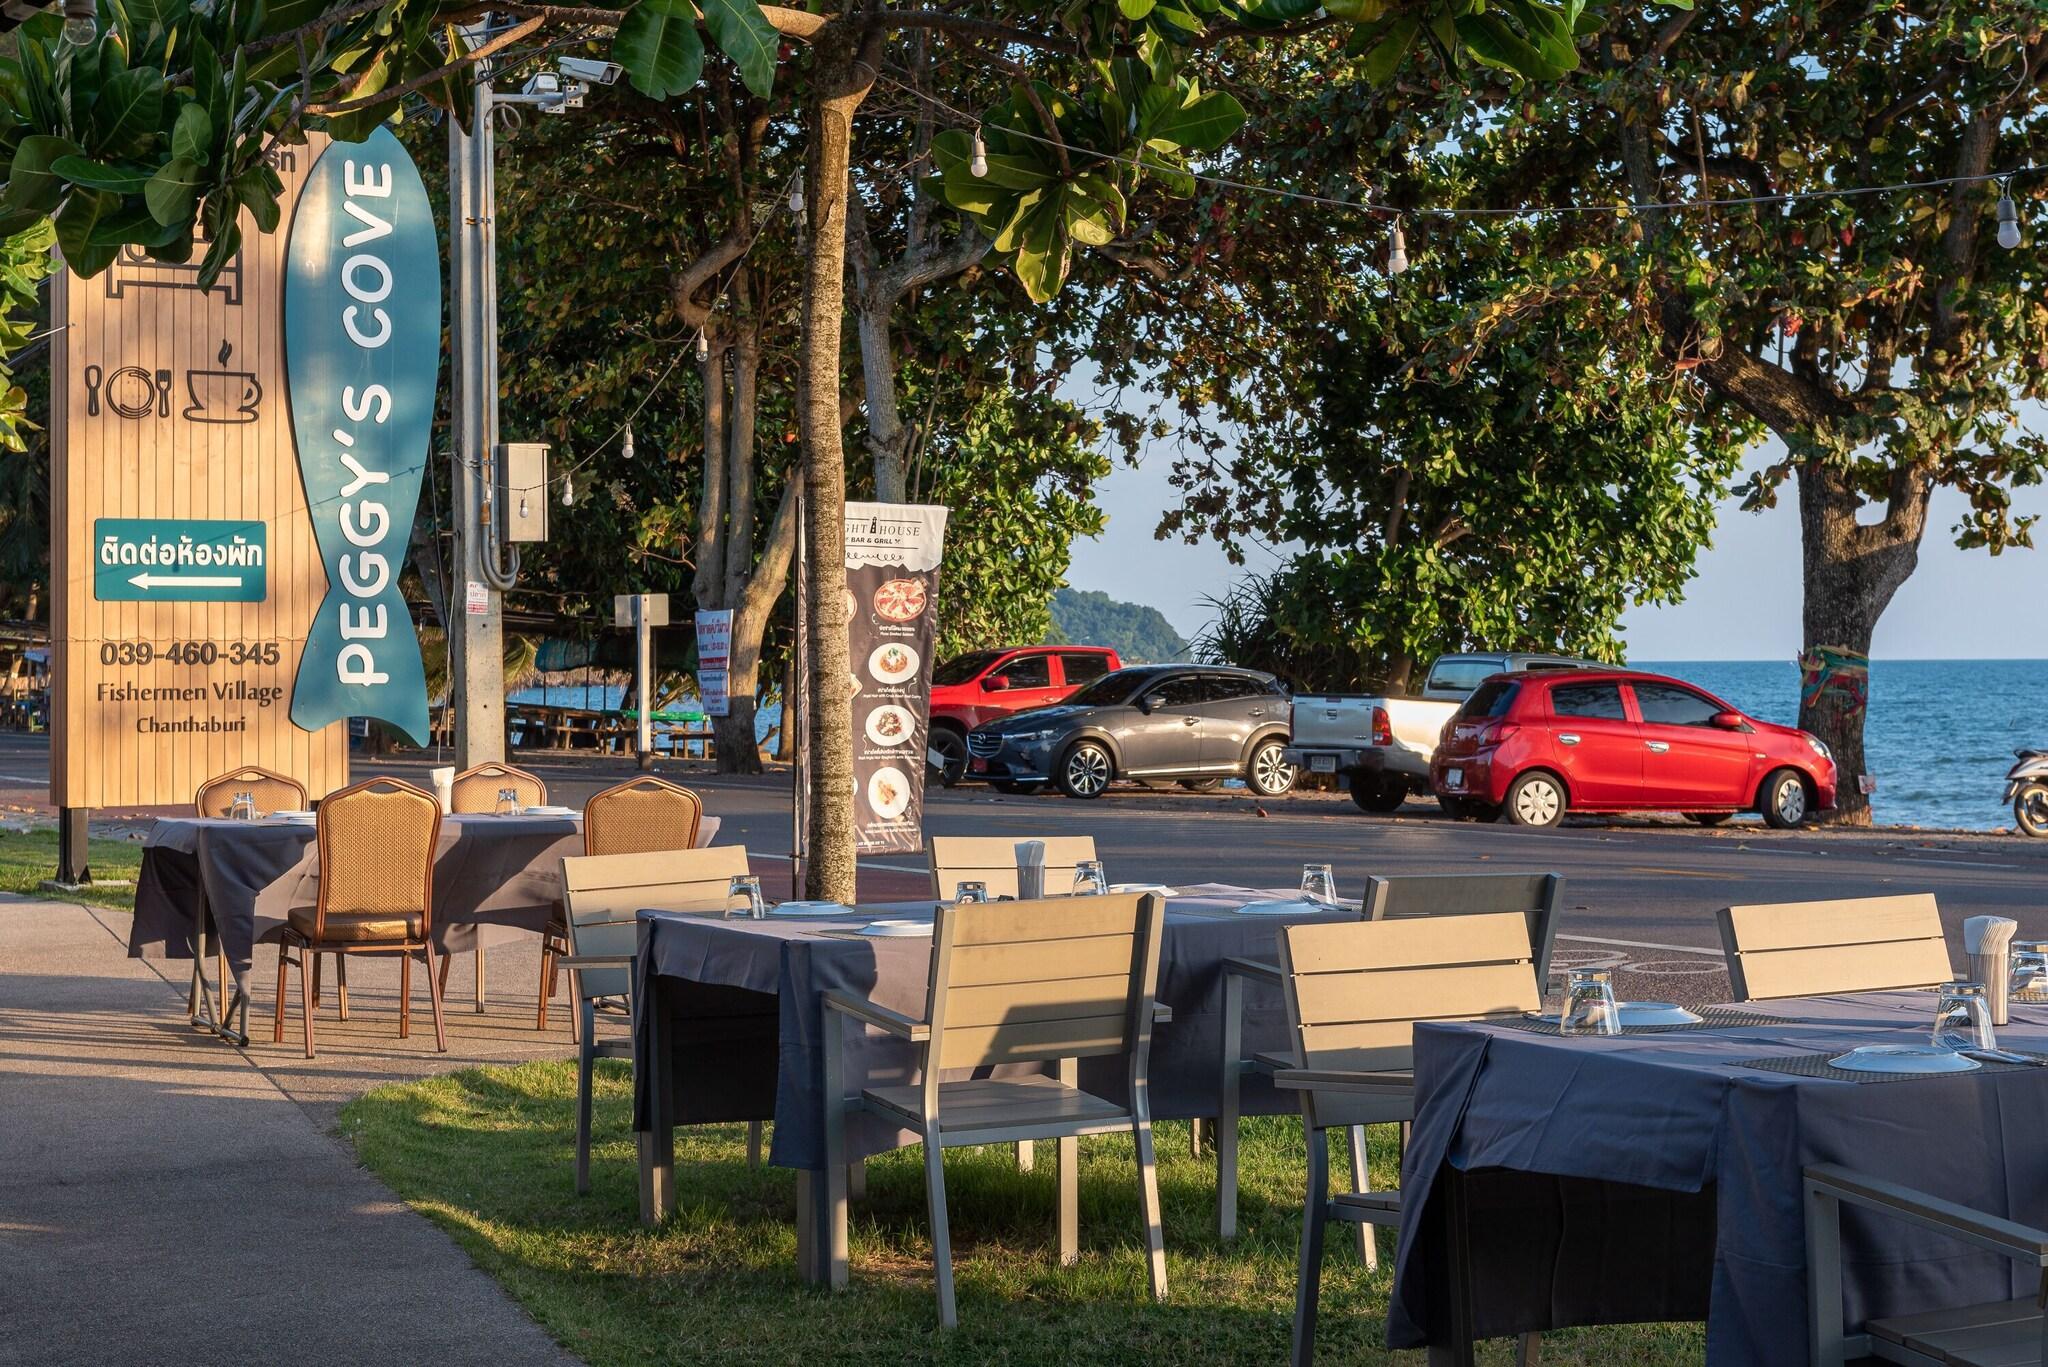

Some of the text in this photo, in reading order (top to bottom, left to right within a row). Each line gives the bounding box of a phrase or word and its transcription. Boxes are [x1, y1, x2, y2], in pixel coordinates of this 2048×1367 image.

[333, 159, 393, 687] PEGGY'S COVE
[879, 525, 920, 536] HOUSE
[100, 535, 263, 567] ติดต่อห้องพัก
[100, 642, 281, 666] 039-460-345
[97, 680, 283, 708] Fishermen Village
[136, 715, 246, 734] Chanthaburi
